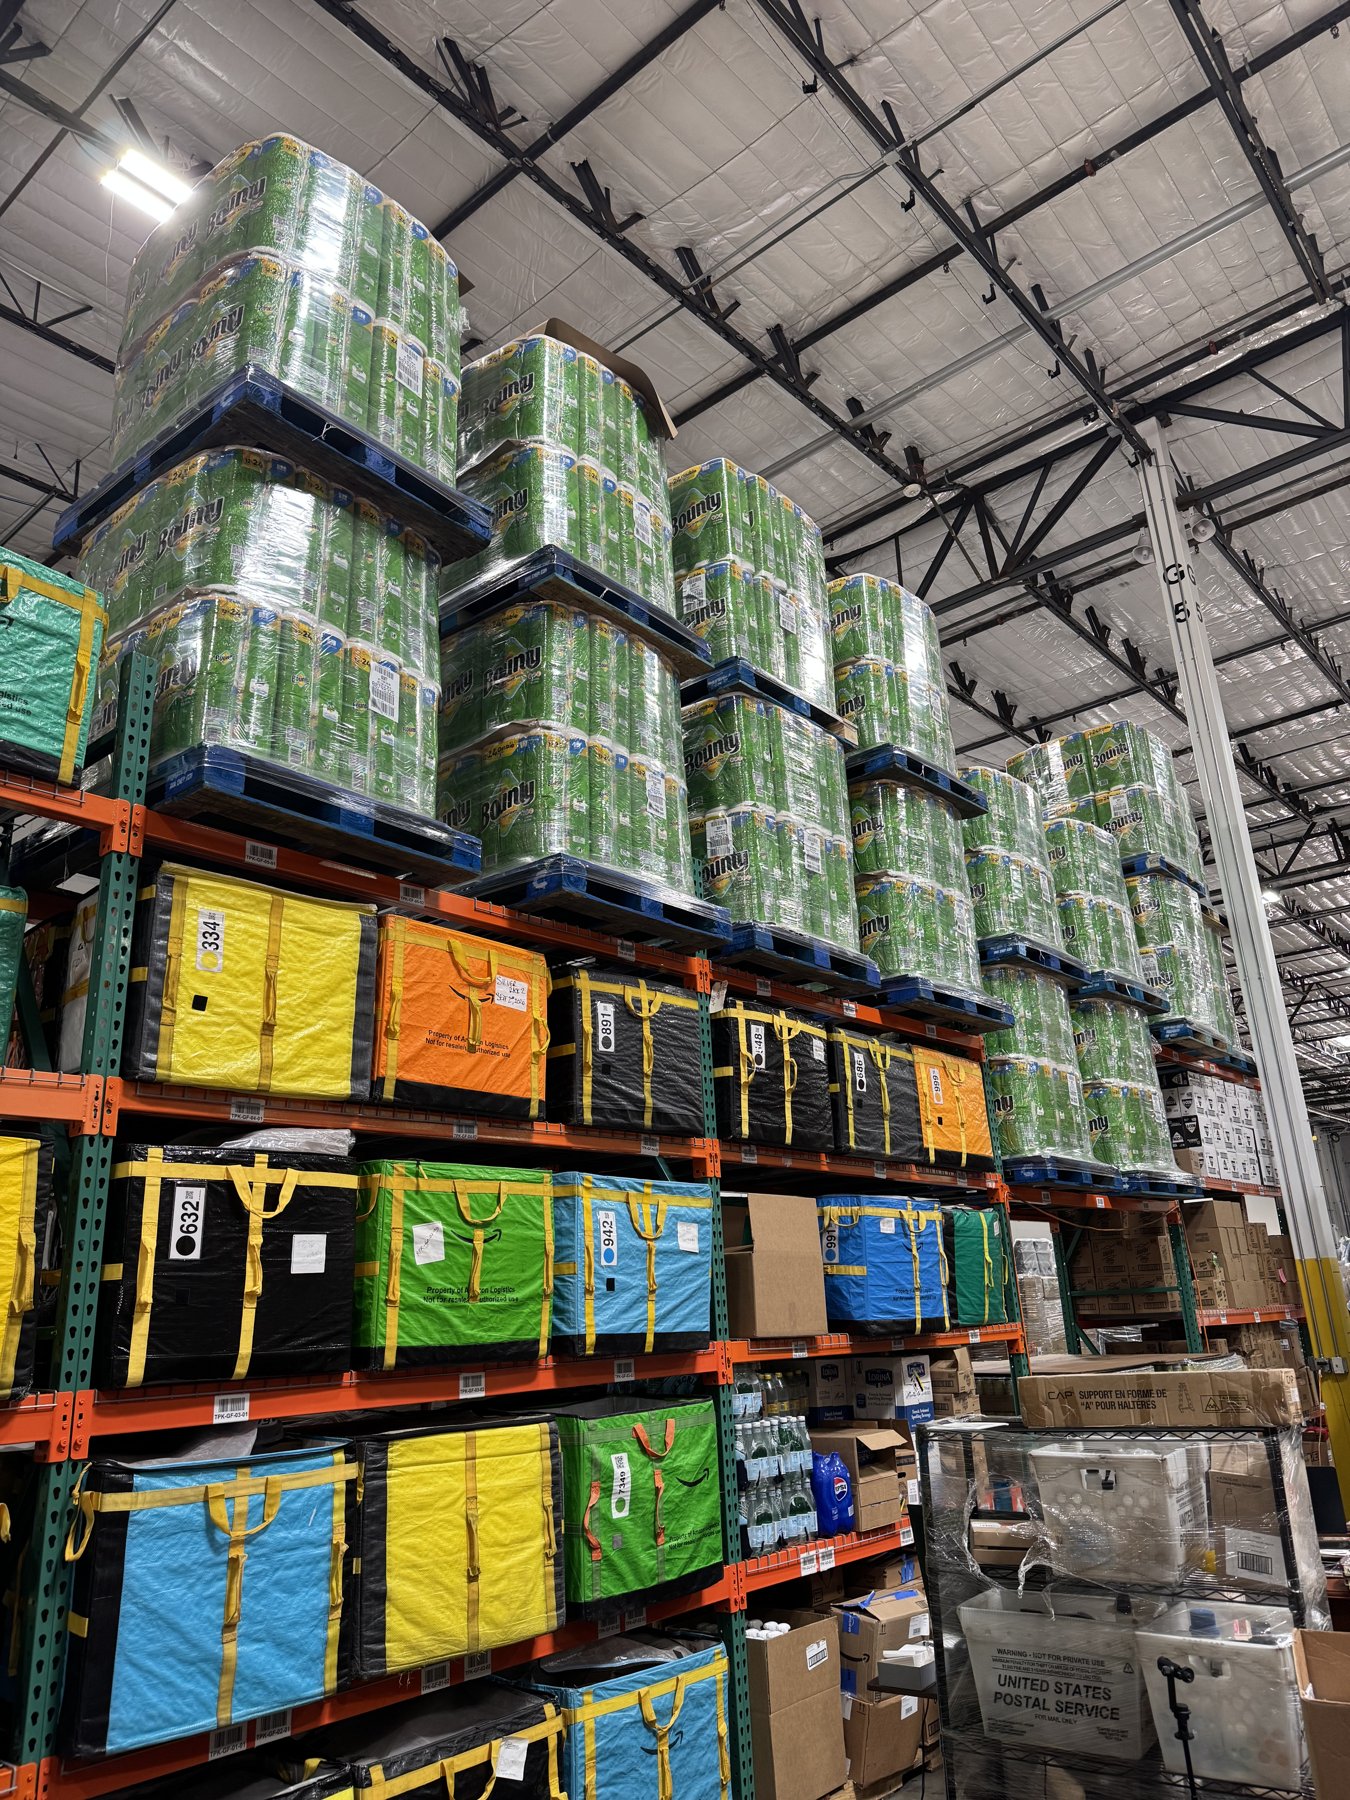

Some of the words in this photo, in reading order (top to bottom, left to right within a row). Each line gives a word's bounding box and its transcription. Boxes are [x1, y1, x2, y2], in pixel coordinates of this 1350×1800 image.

[672, 492, 722, 538] Bounty
[155, 497, 225, 563] Bounty
[1163, 563, 1185, 585] G
[1187, 564, 1196, 586] G
[1174, 600, 1190, 623] 5
[483, 646, 542, 699] Bounty
[16, 704, 32, 716] use
[685, 732, 740, 776] Bounty
[480, 780, 535, 834] Bounty
[1104, 812, 1142, 833] Bounty
[703, 851, 749, 882] ounty
[202, 921, 220, 951] 334
[601, 1012, 612, 1035] 891
[426, 1037, 435, 1045] Not
[436, 1039, 444, 1047] for
[428, 1029, 452, 1041] Property
[485, 1040, 509, 1050] Logistics
[231, 1112, 263, 1122] TPK-GF-04-01
[180, 1201, 200, 1234] 632
[602, 1220, 614, 1247] 942
[826, 1229, 836, 1249] 991
[427, 1287, 455, 1295] Property
[1048, 1391, 1074, 1400] CAP
[1079, 1391, 1114, 1400] SUPPORT
[1116, 1390, 1127, 1399] EN
[1128, 1390, 1156, 1399] FORME
[1157, 1389, 1167, 1398] DE
[1096, 1401, 1116, 1410] POUR
[214, 1411, 248, 1420] TPK-GF-03-01
[618, 1471, 626, 1494] 7349
[996, 1648, 1028, 1658] WARNING
[1032, 1652, 1047, 1660] NOT
[1049, 1654, 1062, 1662] FOR
[1062, 1656, 1089, 1666] PRIVATE
[1091, 1659, 1105, 1667] USE
[998, 1674, 1049, 1692] UNITED
[1054, 1681, 1112, 1701] STATES
[993, 1692, 1050, 1711] POSTAL
[1055, 1700, 1120, 1720] SERVICE
[1062, 1717, 1077, 1725] ONLY
[257, 1727, 290, 1740] TPK-GF-02-01
[210, 1741, 246, 1758] TPK-GF-01-01
